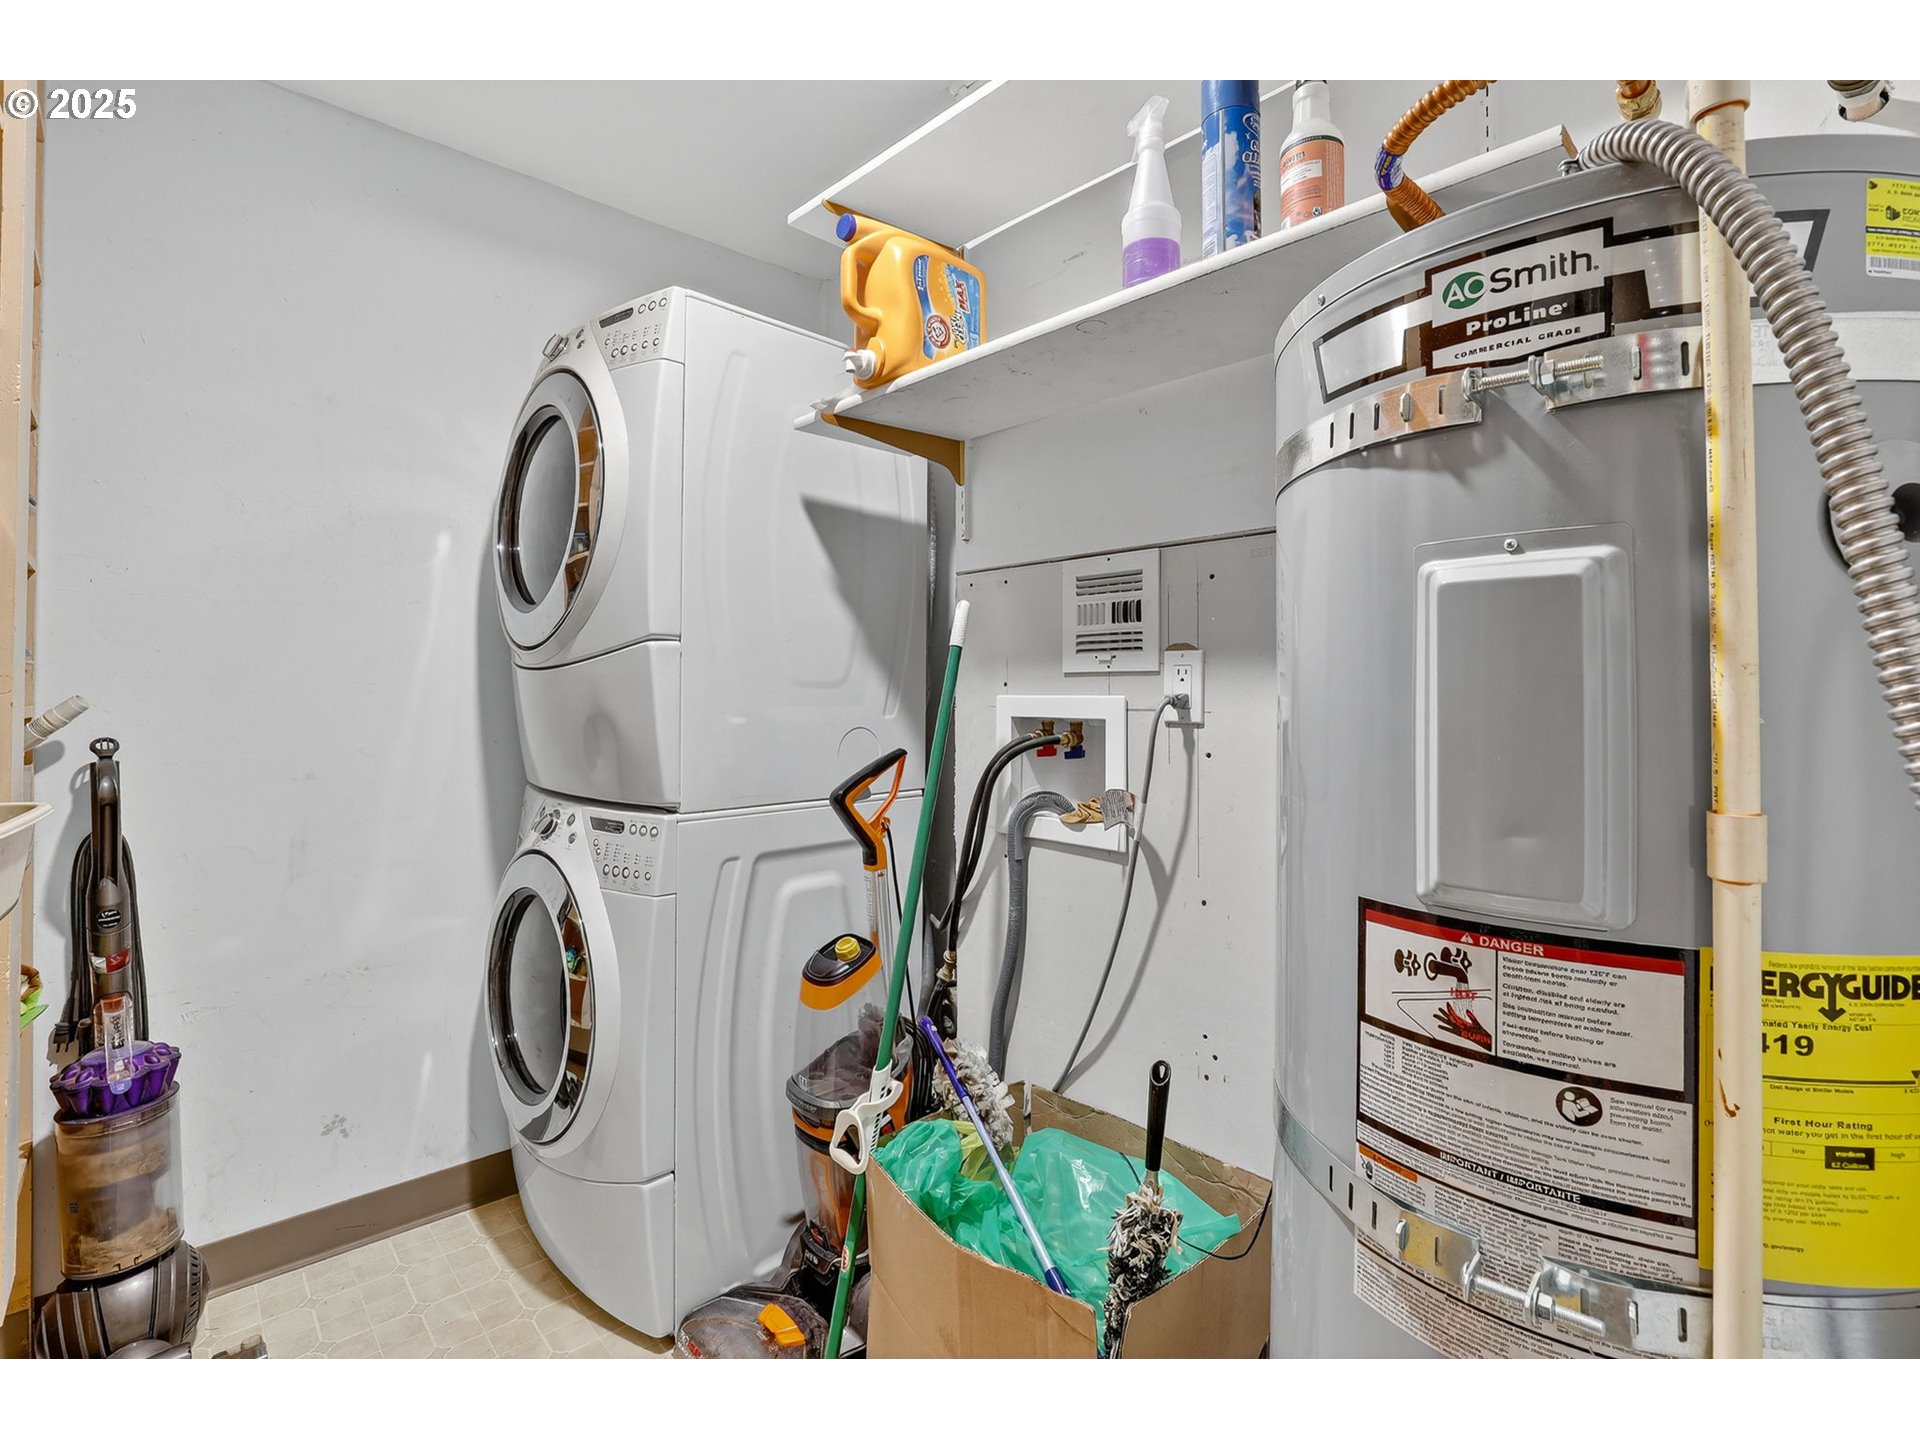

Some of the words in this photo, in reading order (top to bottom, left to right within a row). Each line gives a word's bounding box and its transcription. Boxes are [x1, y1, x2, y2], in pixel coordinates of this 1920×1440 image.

[1454, 337, 1532, 360] COMMERCIAL
[1537, 326, 1582, 341] GRADE
[1479, 936, 1544, 956] DANGER
[1774, 1117, 1801, 1126] First
[1805, 1120, 1833, 1128] Hour
[1837, 1121, 1873, 1131] Rating
[1440, 1152, 1497, 1178] IMPORTANT
[1506, 1175, 1581, 1204] IMPORTANTE
